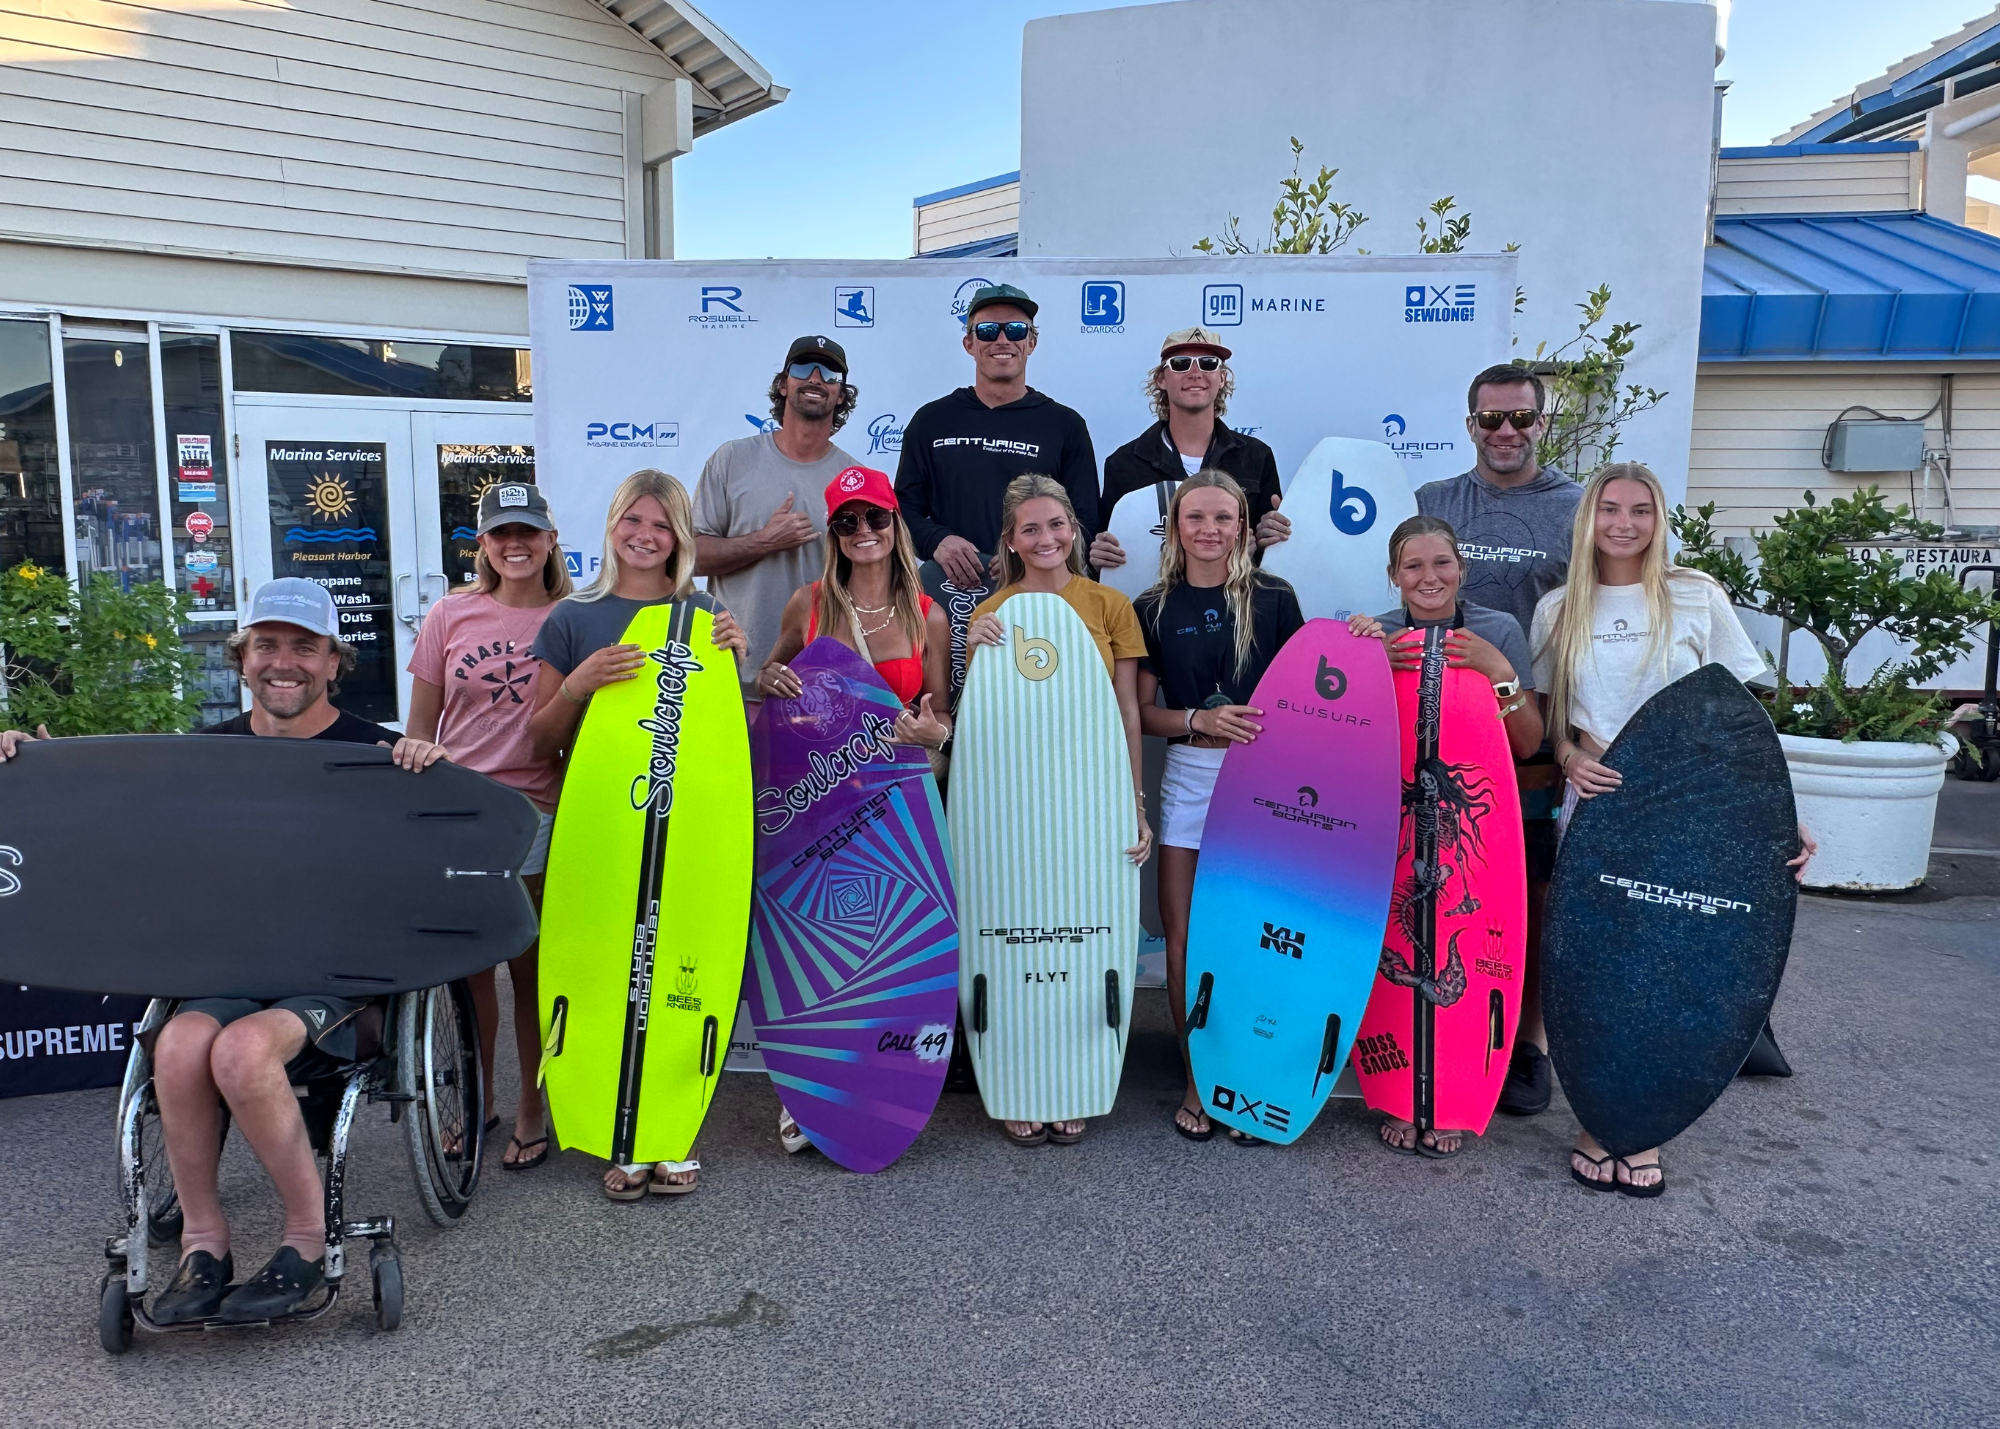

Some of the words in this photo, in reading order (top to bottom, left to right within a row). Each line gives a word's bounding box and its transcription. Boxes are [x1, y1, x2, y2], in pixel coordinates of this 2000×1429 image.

[1251, 299, 1326, 311] MARINE
[1080, 326, 1126, 334] BOARDCO
[587, 423, 654, 440] PCM
[933, 437, 1039, 453] CENTURION
[270, 449, 323, 461] Marina
[326, 450, 382, 462] Services
[441, 452, 487, 464] Marina
[293, 552, 335, 561] Pleasant
[337, 552, 371, 561] Harbor
[1905, 549, 1992, 564] RESTAURA
[333, 593, 371, 605] Wash
[341, 612, 372, 623] Outs
[338, 631, 377, 642] sories
[455, 641, 516, 680] PHASE
[1277, 699, 1372, 727] BLUSURF
[757, 712, 897, 836] Soulcraft
[1253, 797, 1357, 831] CENTURION
[1271, 809, 1334, 832] BOATS
[791, 781, 901, 869] CENTURION
[820, 806, 887, 862] BOATS
[1600, 874, 1751, 913] CENTURION
[1627, 889, 1717, 915] BOATS
[979, 926, 1112, 936] CENTURION
[1006, 935, 1084, 945] BOATS
[629, 923, 646, 1003] BOATS
[637, 899, 660, 1031] CENTURION
[1024, 971, 1069, 984] FLYT
[877, 1030, 916, 1053] CALI
[920, 1031, 949, 1056] 49
[1359, 1048, 1410, 1076] SAUCE
